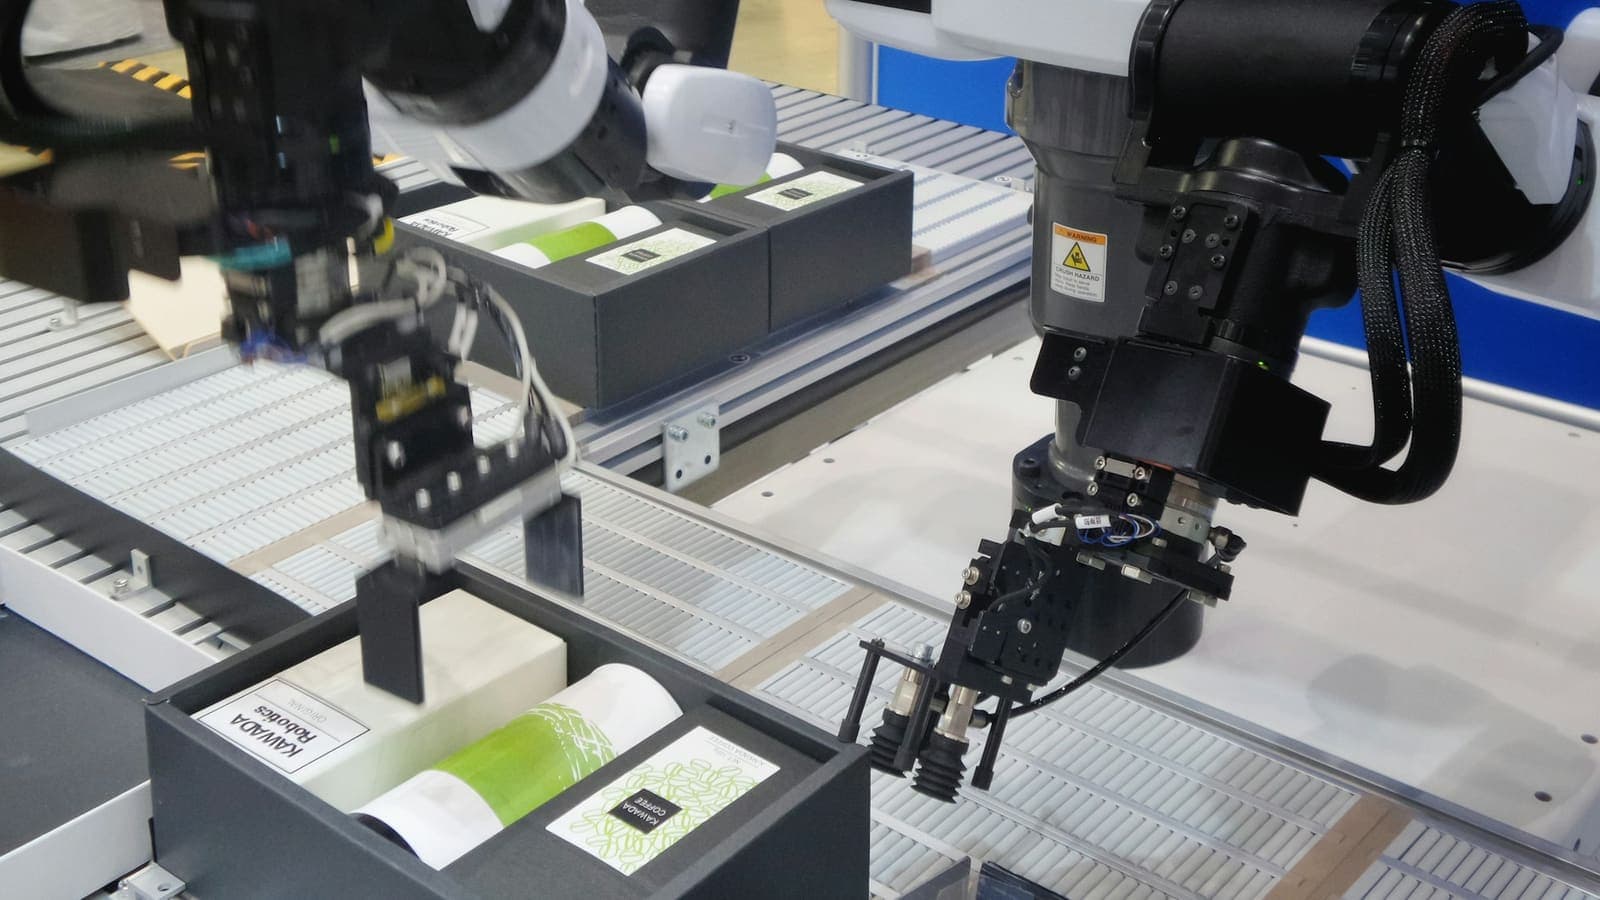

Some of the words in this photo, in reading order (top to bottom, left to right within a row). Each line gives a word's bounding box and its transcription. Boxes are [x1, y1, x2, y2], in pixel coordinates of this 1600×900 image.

[1066, 231, 1097, 243] WARNING
[1074, 272, 1100, 282] HAZARD
[287, 698, 327, 724] ORIGINAL
[230, 713, 304, 758] KAWADA
[254, 705, 318, 744] Robotics
[622, 802, 660, 826] KAWADA
[633, 796, 666, 817] COFFEE
